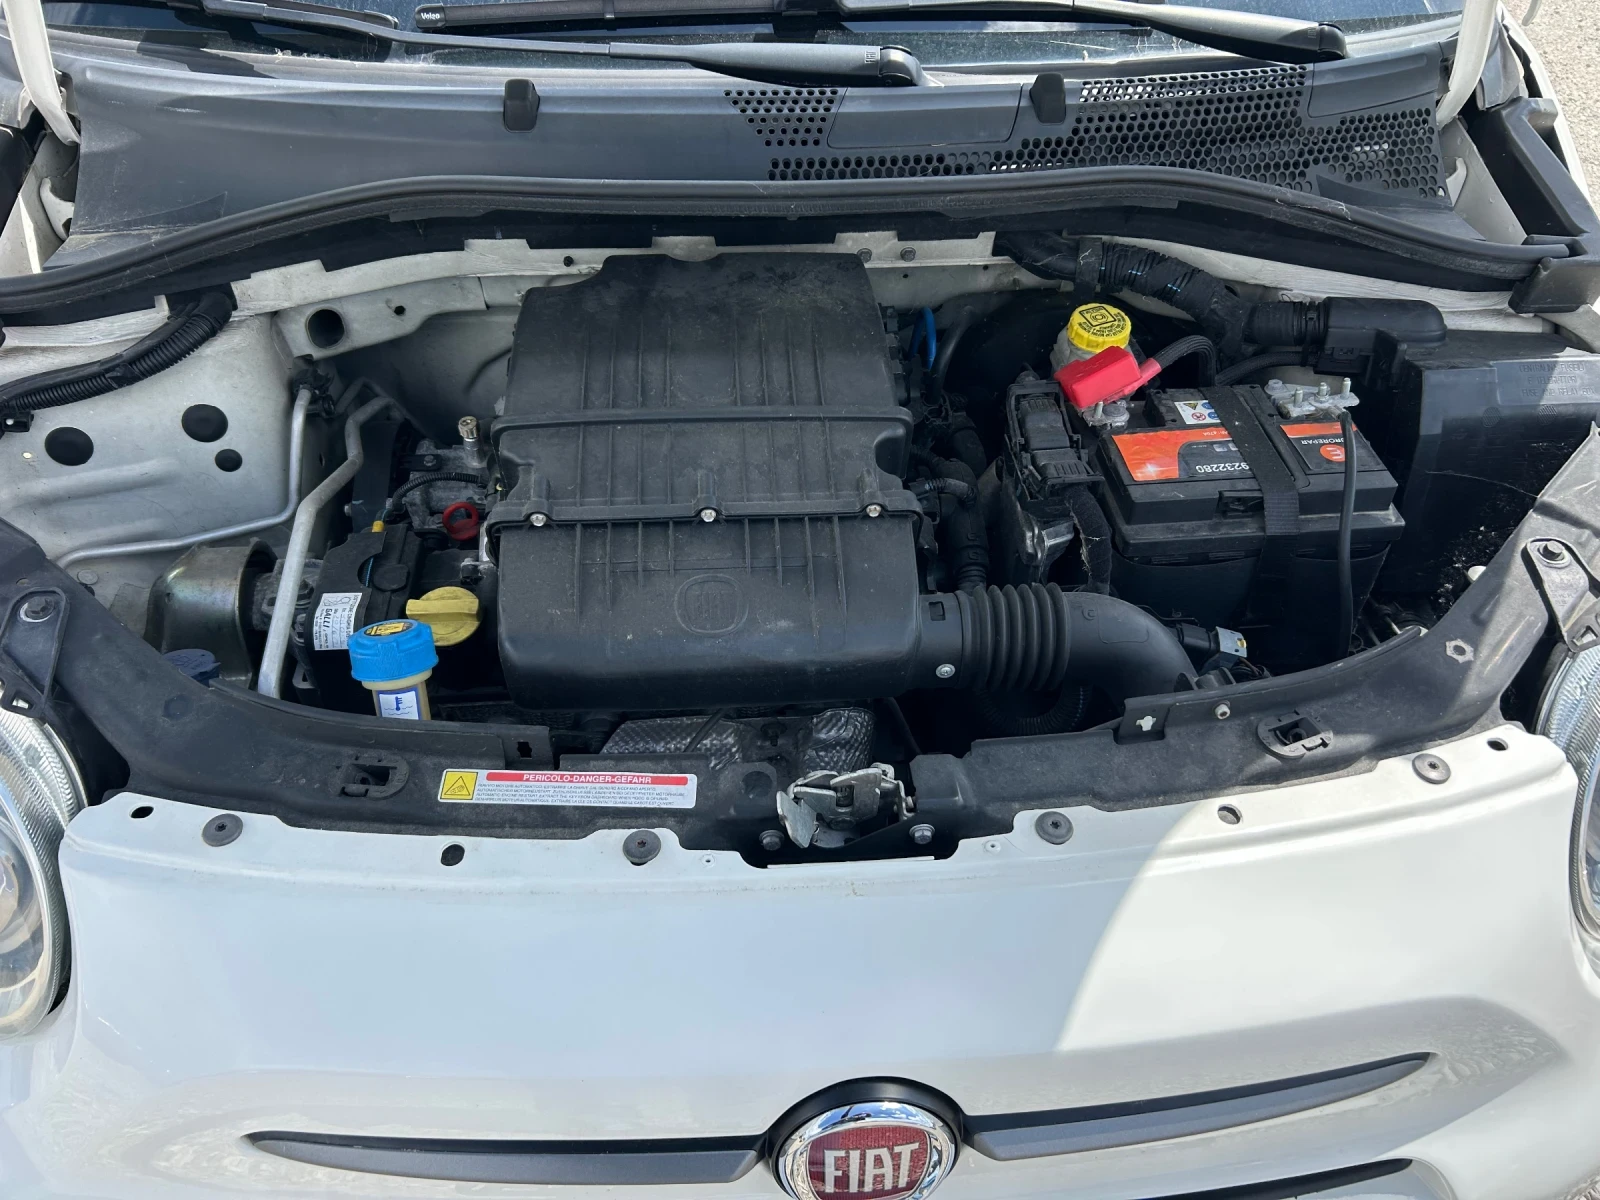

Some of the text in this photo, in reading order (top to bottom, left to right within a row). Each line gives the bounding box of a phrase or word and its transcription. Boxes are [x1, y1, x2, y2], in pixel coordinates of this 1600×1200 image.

[1196, 462, 1249, 473] 9232280
[523, 774, 652, 784] PERICOLO-DANGER-GEFAHR
[824, 1142, 920, 1194] FIAT
